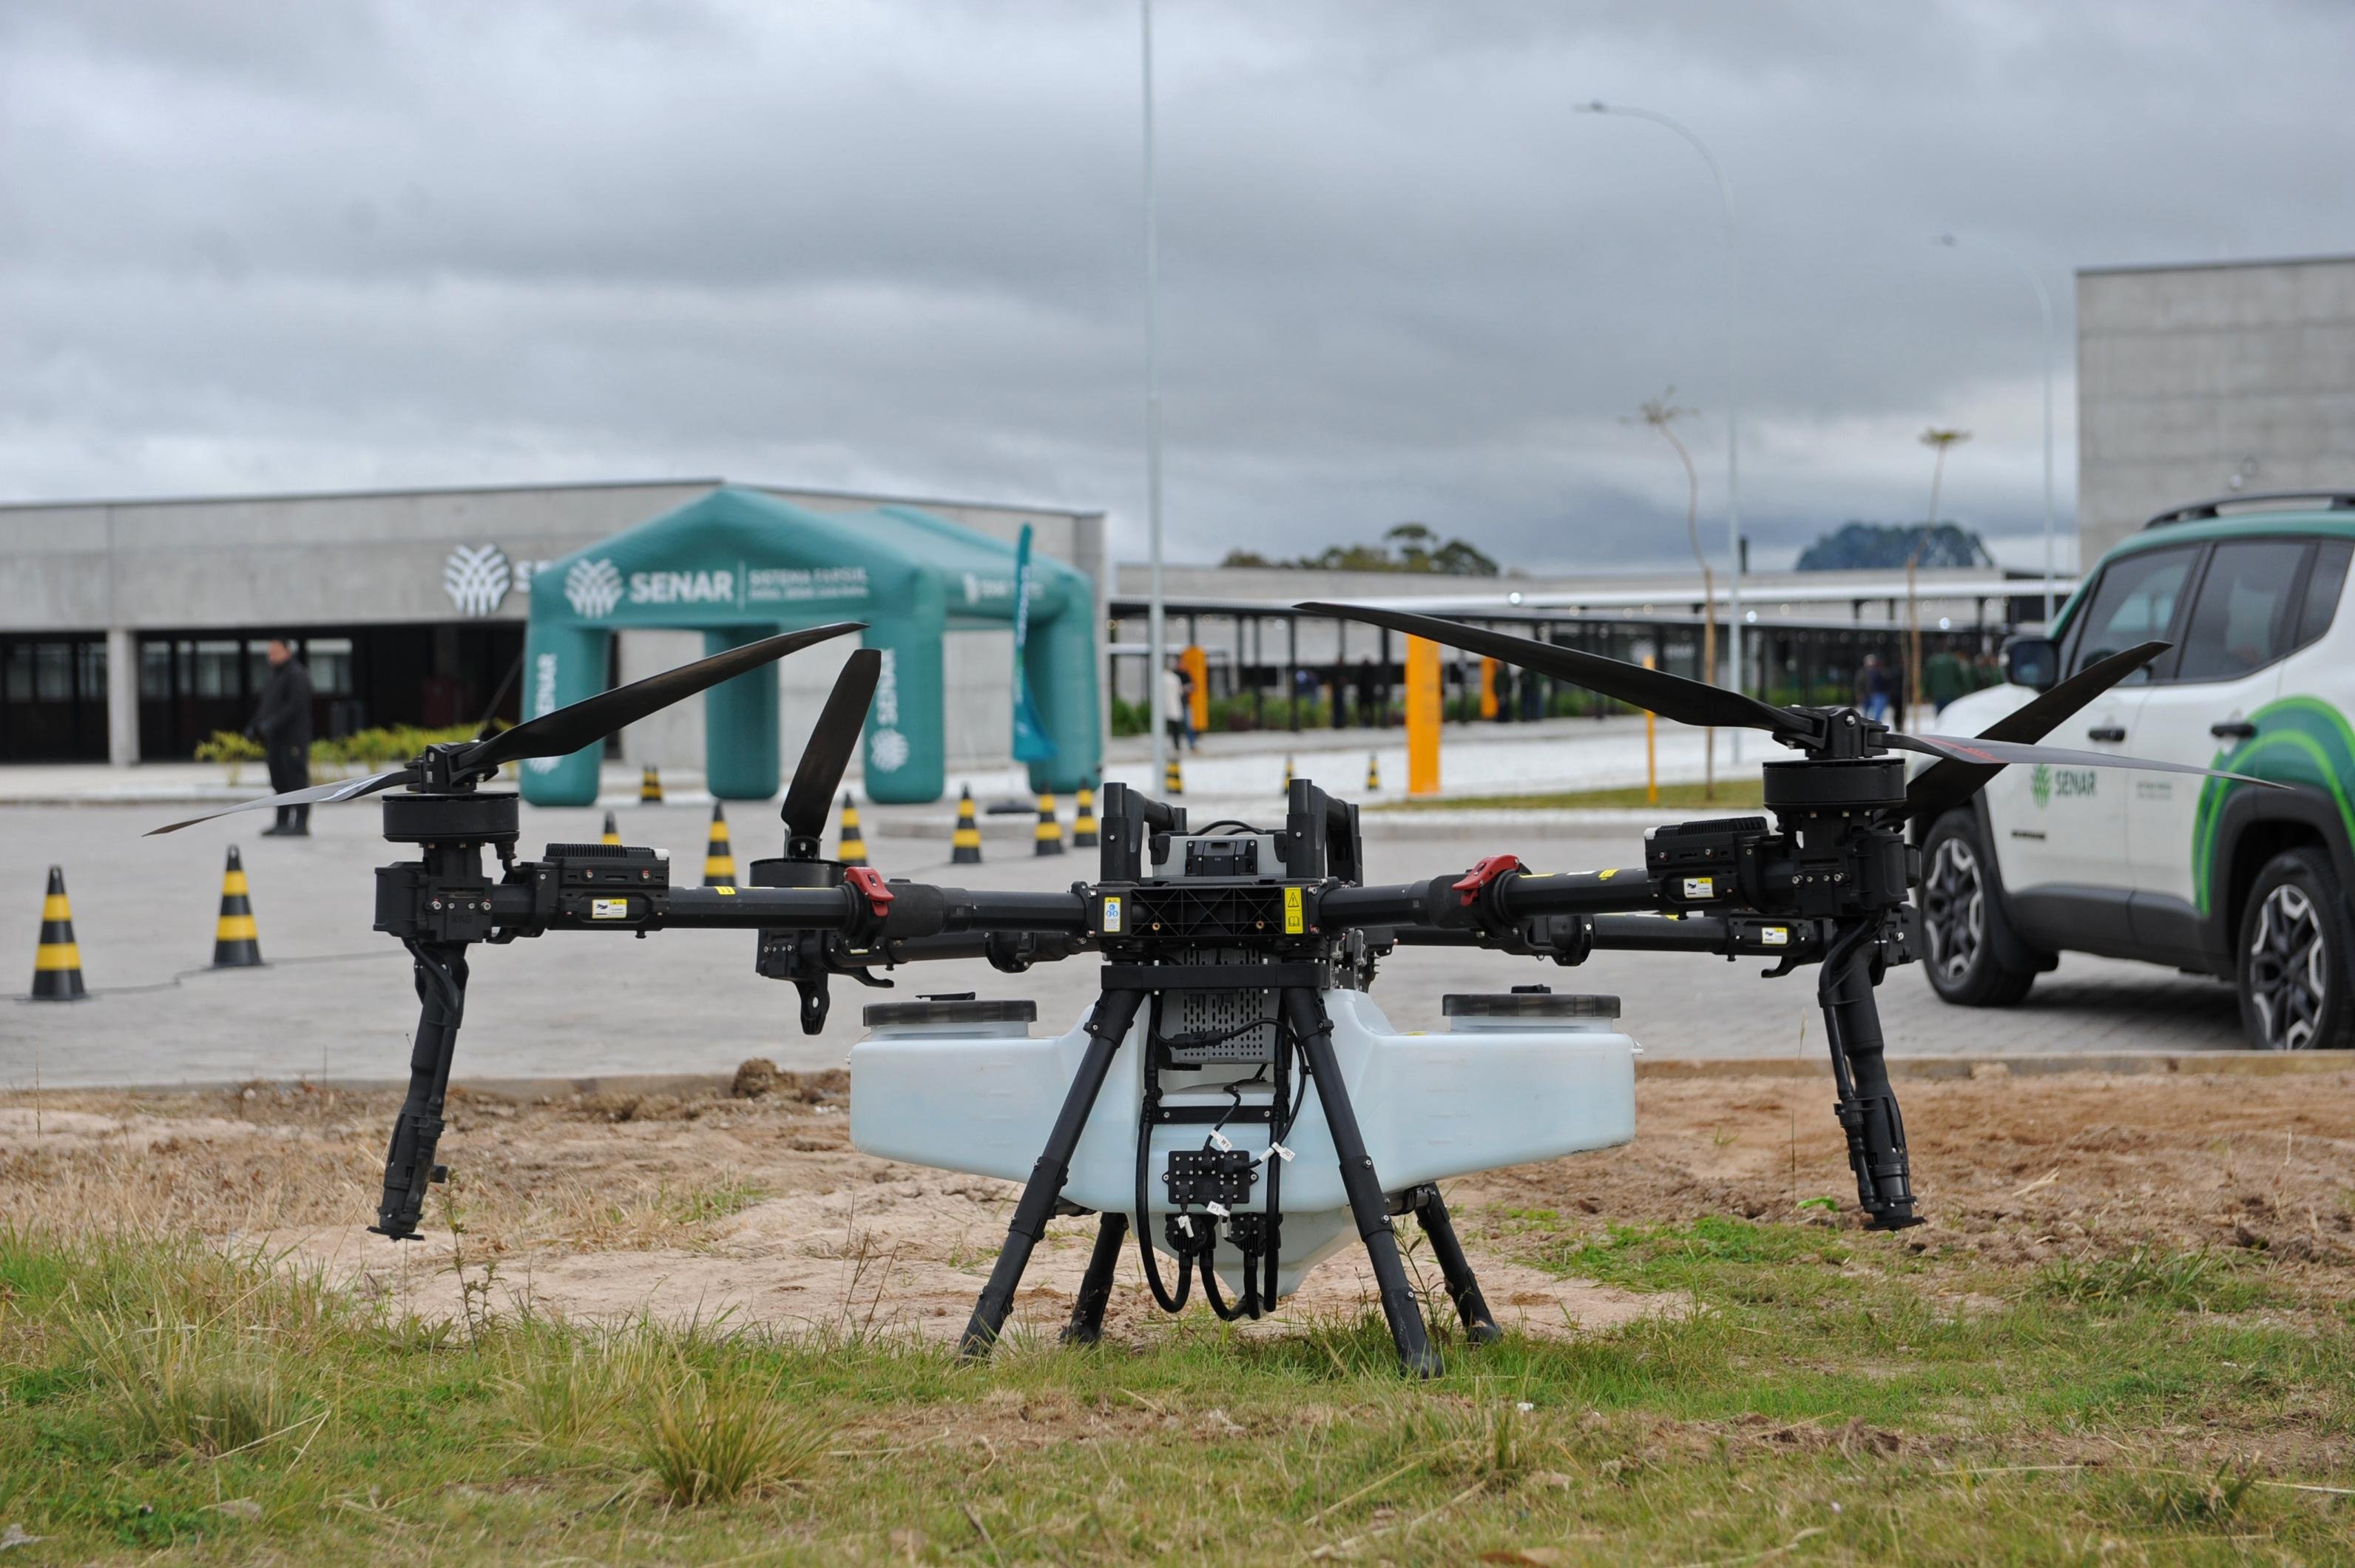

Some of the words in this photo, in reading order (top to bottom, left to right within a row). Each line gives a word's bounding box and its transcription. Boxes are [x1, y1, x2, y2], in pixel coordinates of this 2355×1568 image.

[630, 570, 732, 604] SENAR
[535, 653, 556, 717] ENAR
[2055, 770, 2096, 796] SENAR
